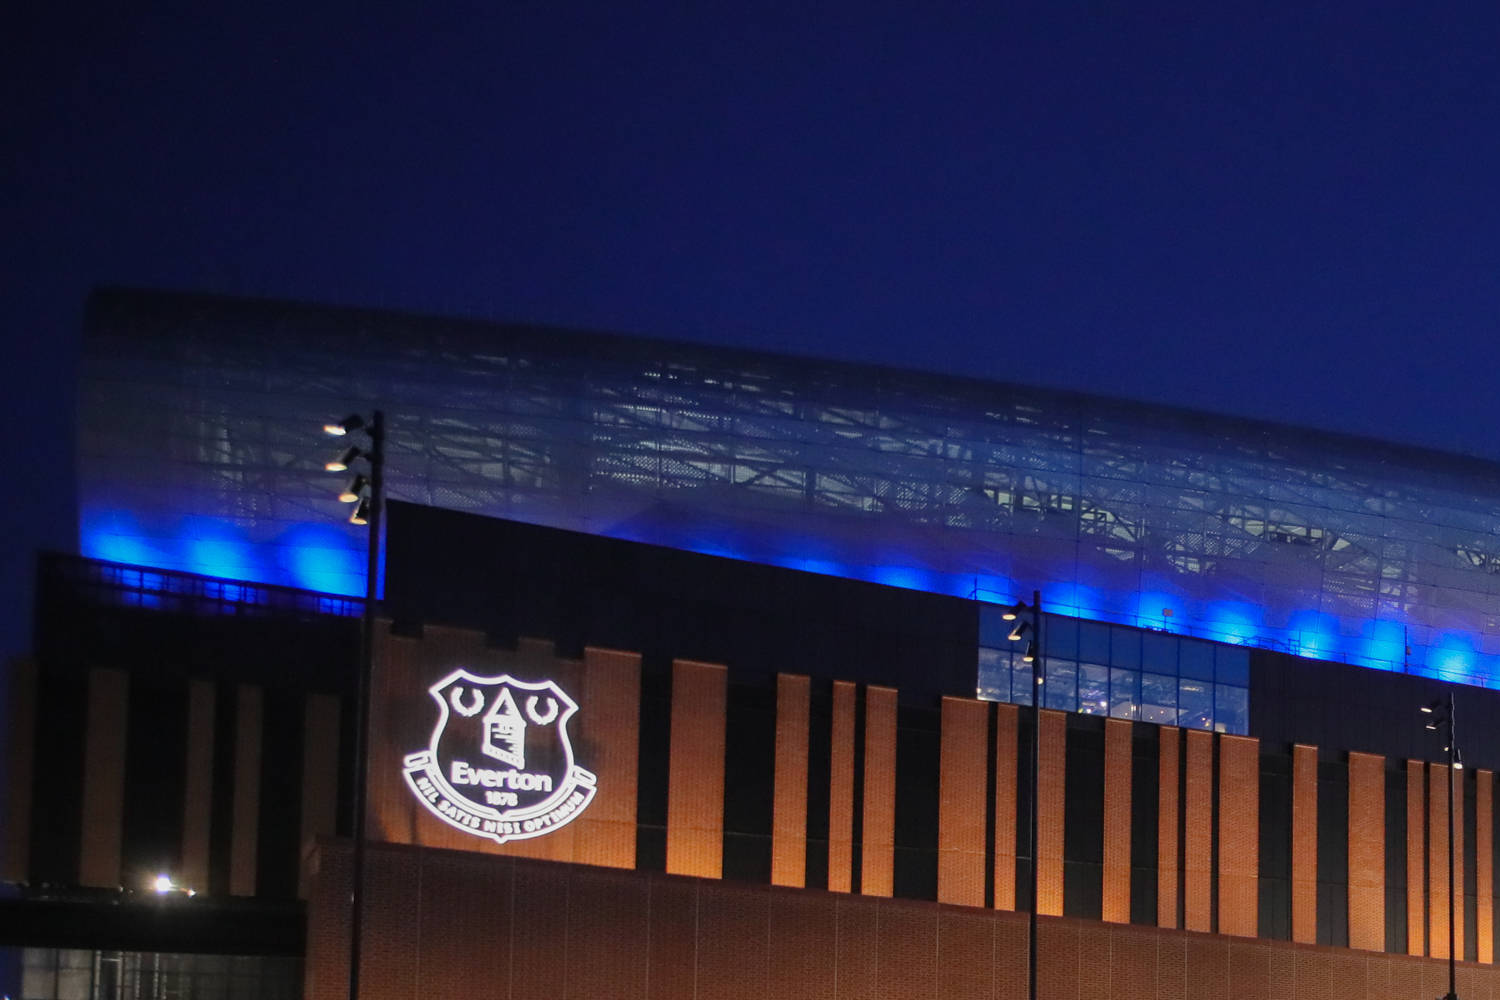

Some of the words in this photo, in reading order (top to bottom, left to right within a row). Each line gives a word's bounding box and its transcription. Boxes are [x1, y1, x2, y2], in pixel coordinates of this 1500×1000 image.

[451, 760, 553, 793] Everton
[416, 777, 438, 803] NIL
[437, 799, 481, 829] SATIS
[484, 820, 522, 834] NISI
[523, 791, 585, 833] OPTIMUM
